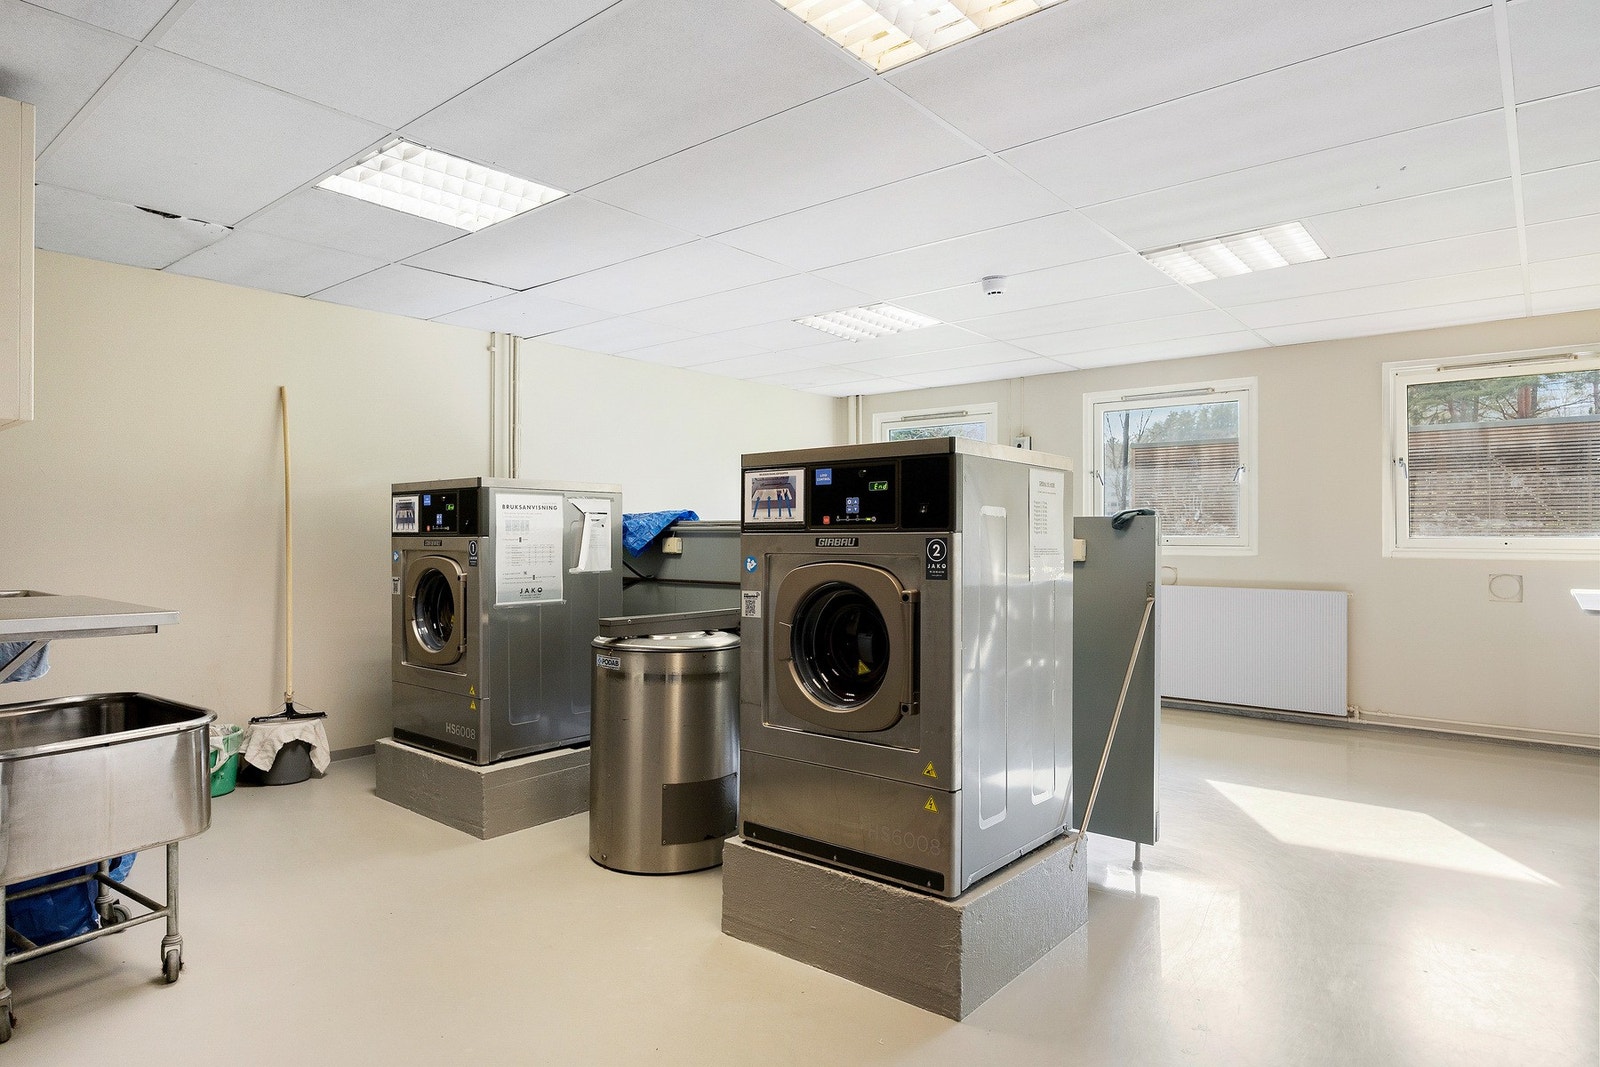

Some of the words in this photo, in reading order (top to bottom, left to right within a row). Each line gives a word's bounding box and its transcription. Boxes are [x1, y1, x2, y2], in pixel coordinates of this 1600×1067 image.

[818, 538, 855, 546] GIRBAU
[932, 544, 941, 557] 2
[602, 658, 620, 667] PODAB
[445, 722, 476, 740] HS6008
